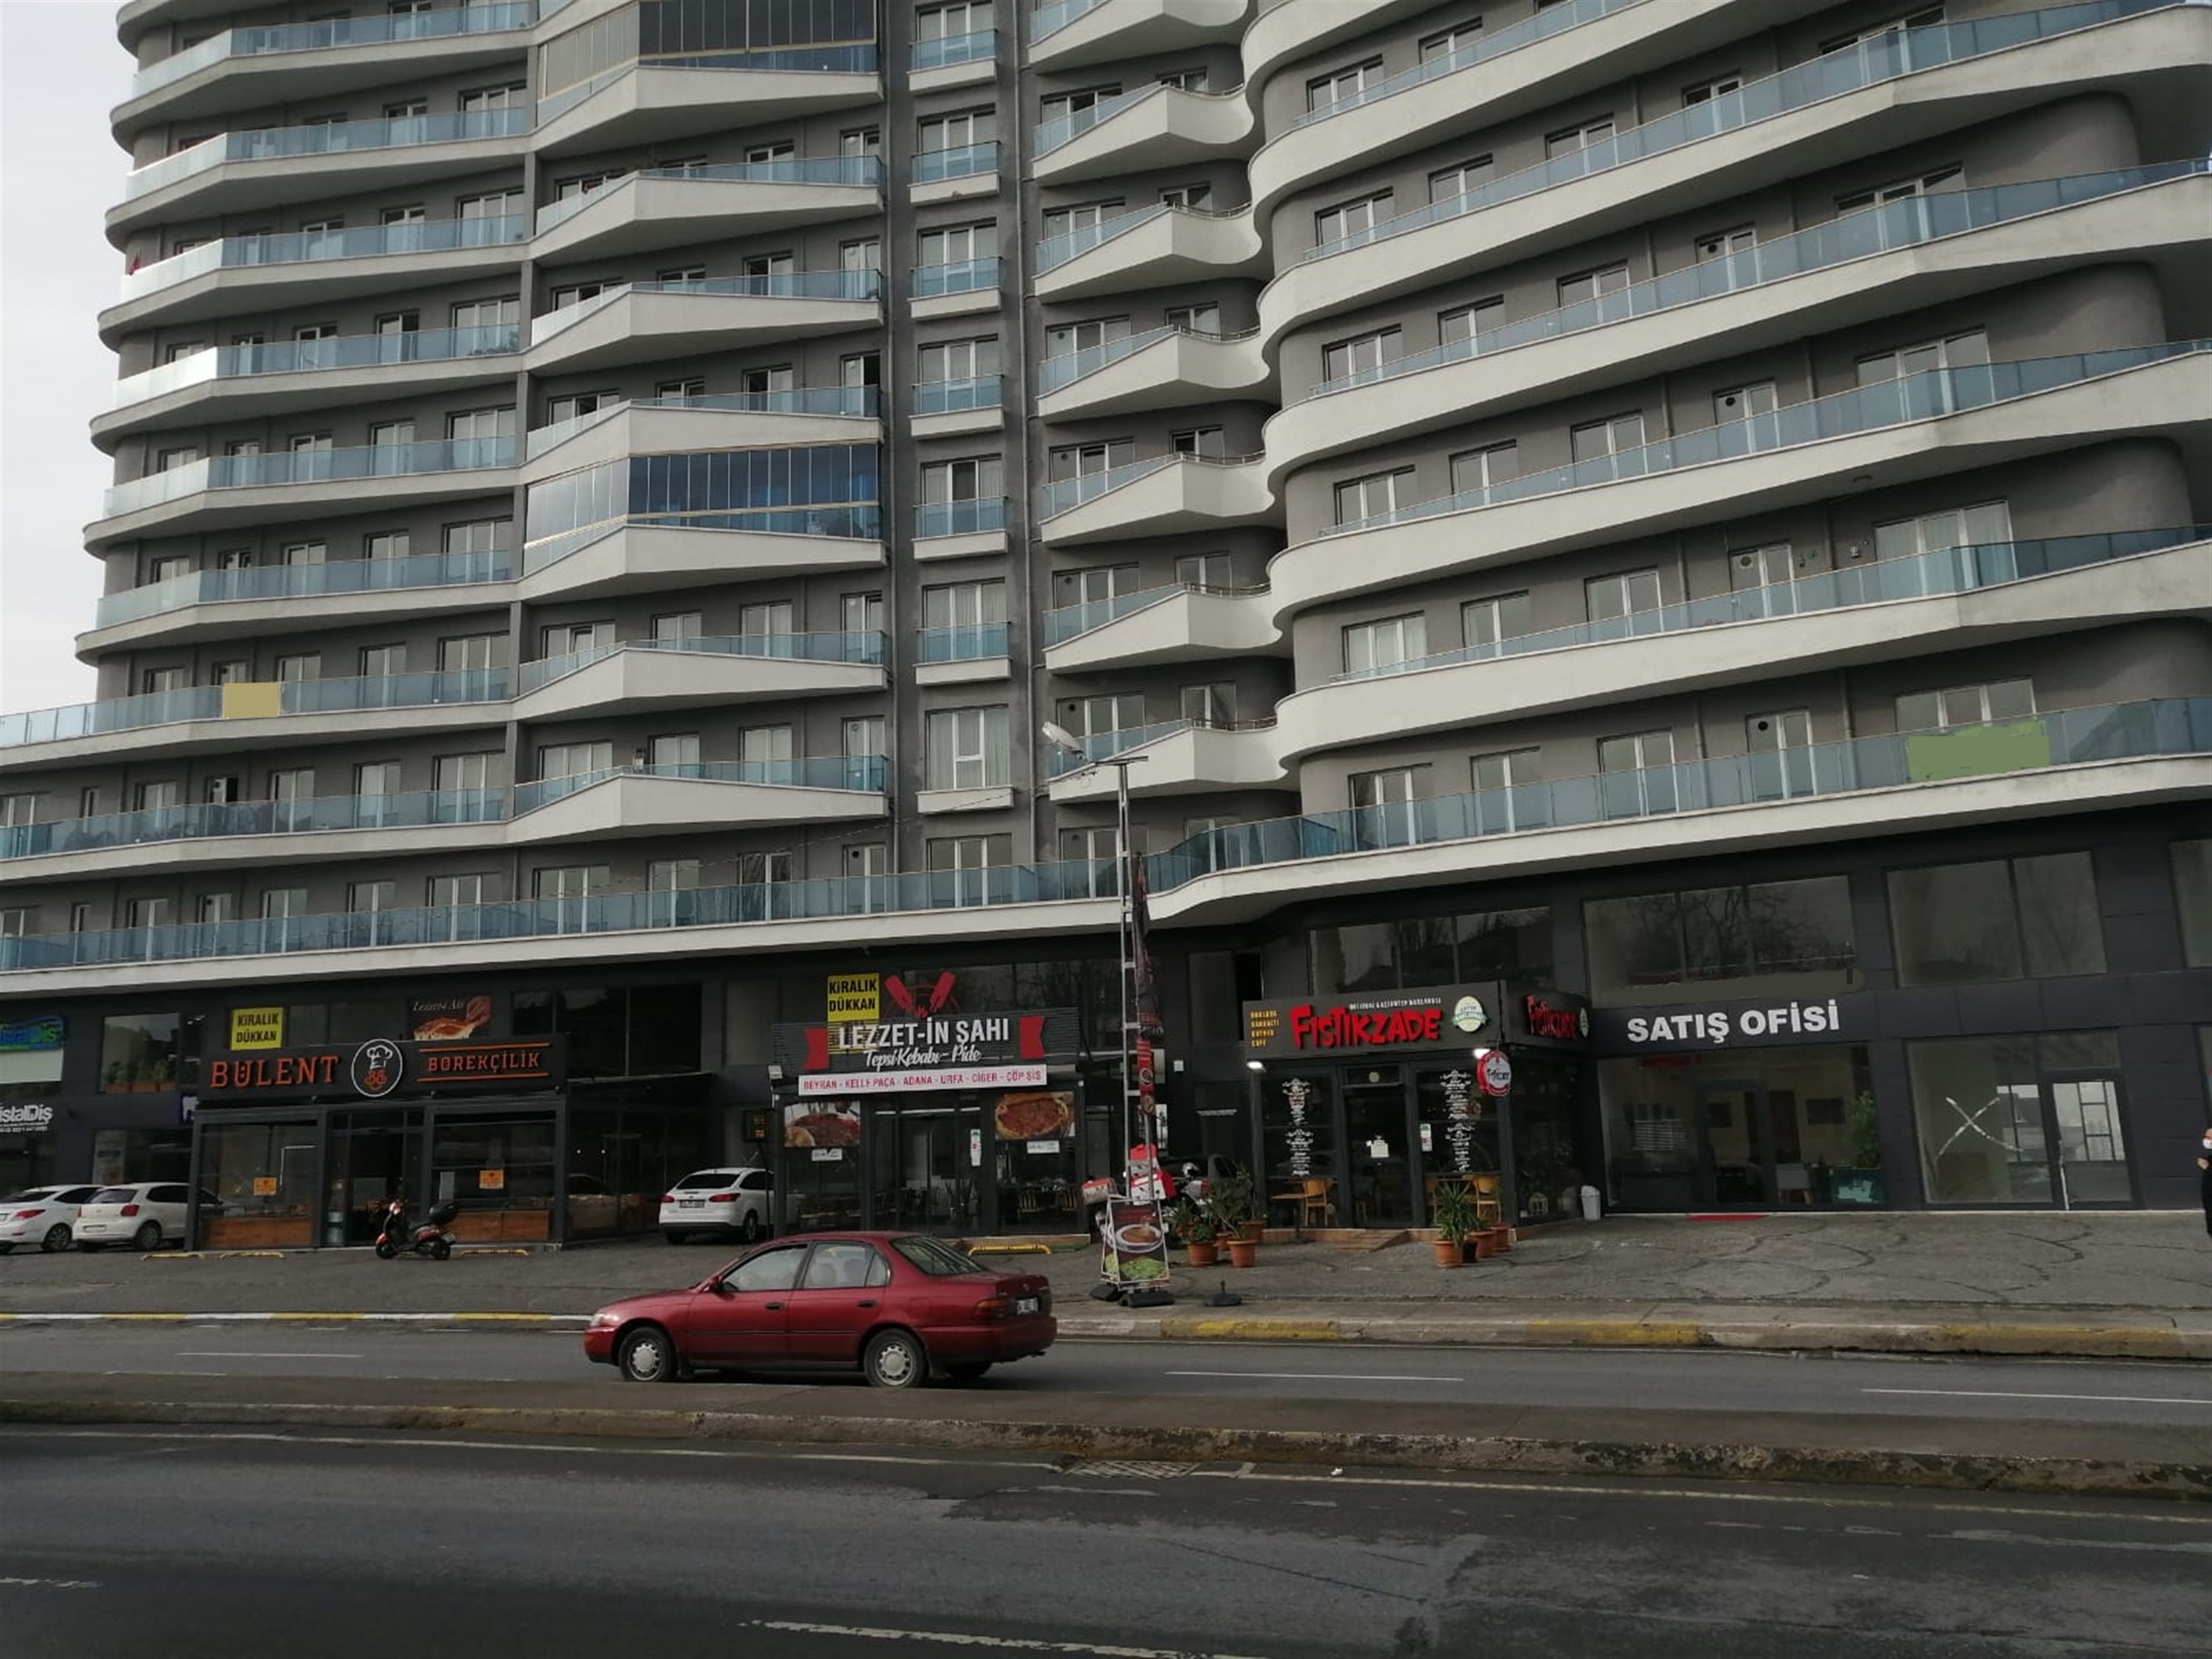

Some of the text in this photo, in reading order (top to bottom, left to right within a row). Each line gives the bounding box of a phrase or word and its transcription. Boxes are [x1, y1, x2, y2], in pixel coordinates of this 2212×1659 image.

[829, 978, 877, 994] KİRALIK
[829, 997, 876, 1012] DÜKKAN
[1290, 1004, 1442, 1049] FISTIKZADE
[1627, 998, 1840, 1044] SATIŞ OFİSİ
[236, 1029, 276, 1043] DÜKKAN
[956, 1018, 1009, 1045] ŞAHI
[428, 1050, 540, 1073] BÖREKÇİLİK
[951, 1044, 983, 1062] Pide
[209, 1056, 339, 1088] BÜLENT
[903, 1076, 932, 1085] ADANA
[940, 1074, 964, 1085] URFA
